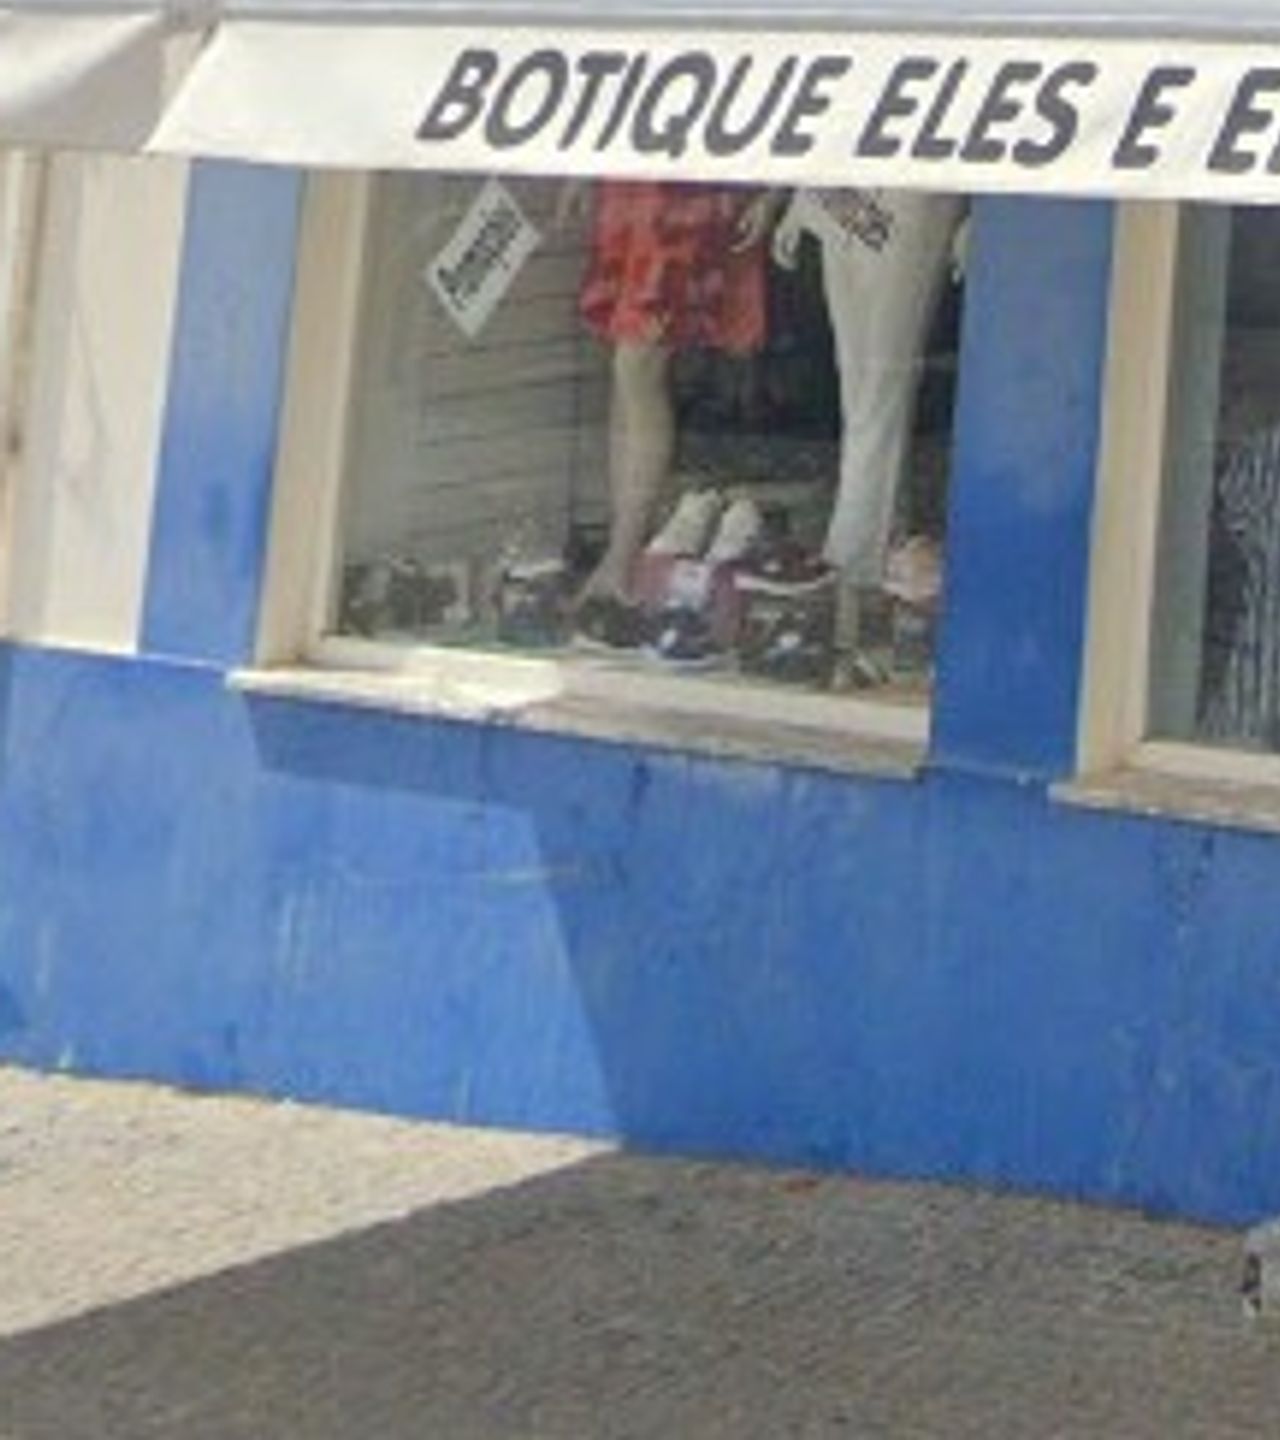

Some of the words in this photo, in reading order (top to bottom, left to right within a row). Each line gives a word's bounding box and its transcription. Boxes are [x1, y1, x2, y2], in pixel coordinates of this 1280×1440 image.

[416, 48, 852, 158] BOTIQUE
[855, 58, 1098, 168] ELES
[1112, 66, 1196, 170] E
